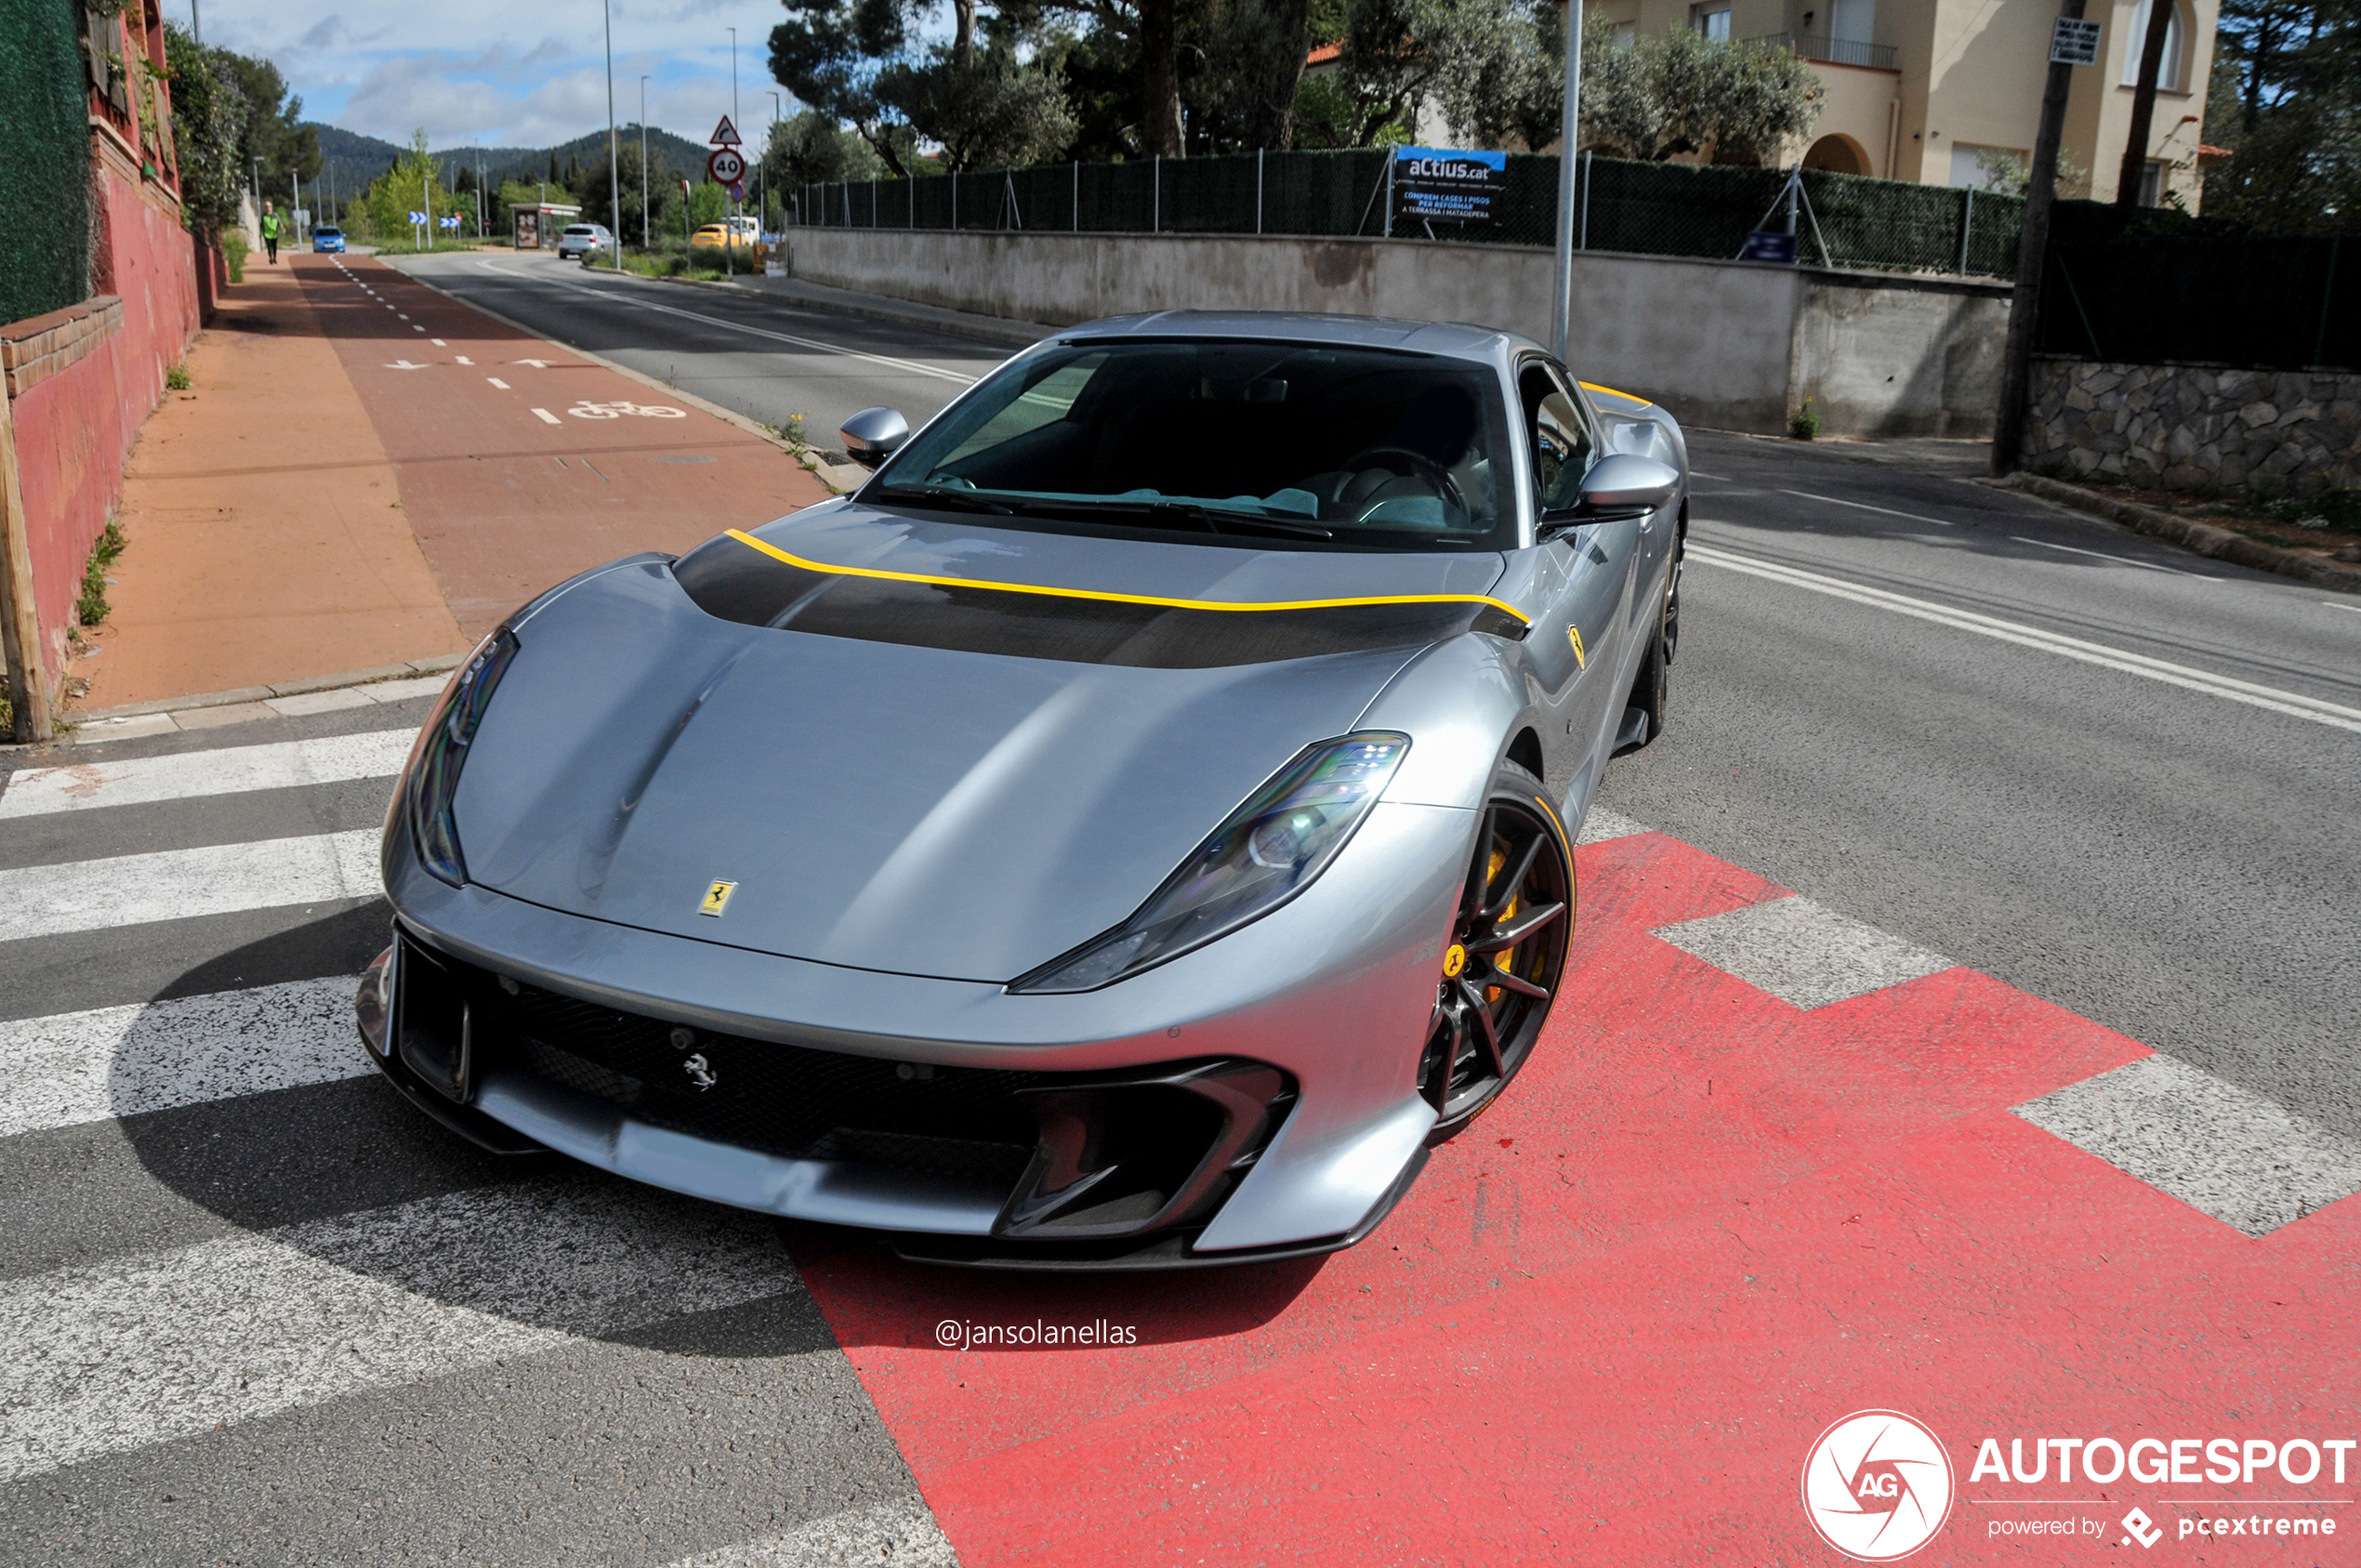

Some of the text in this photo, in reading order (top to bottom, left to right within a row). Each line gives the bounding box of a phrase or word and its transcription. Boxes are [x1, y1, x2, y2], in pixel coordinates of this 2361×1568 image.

[717, 160, 738, 173] 40
[1404, 191, 1439, 201] COMPREM
[1440, 194, 1463, 203] CASES
[1469, 196, 1490, 204] PISOS
[1408, 206, 1442, 215] TERRASSA
[1445, 209, 1489, 218] MATADEPERA
[1434, 202, 1474, 210] REFORMAR
